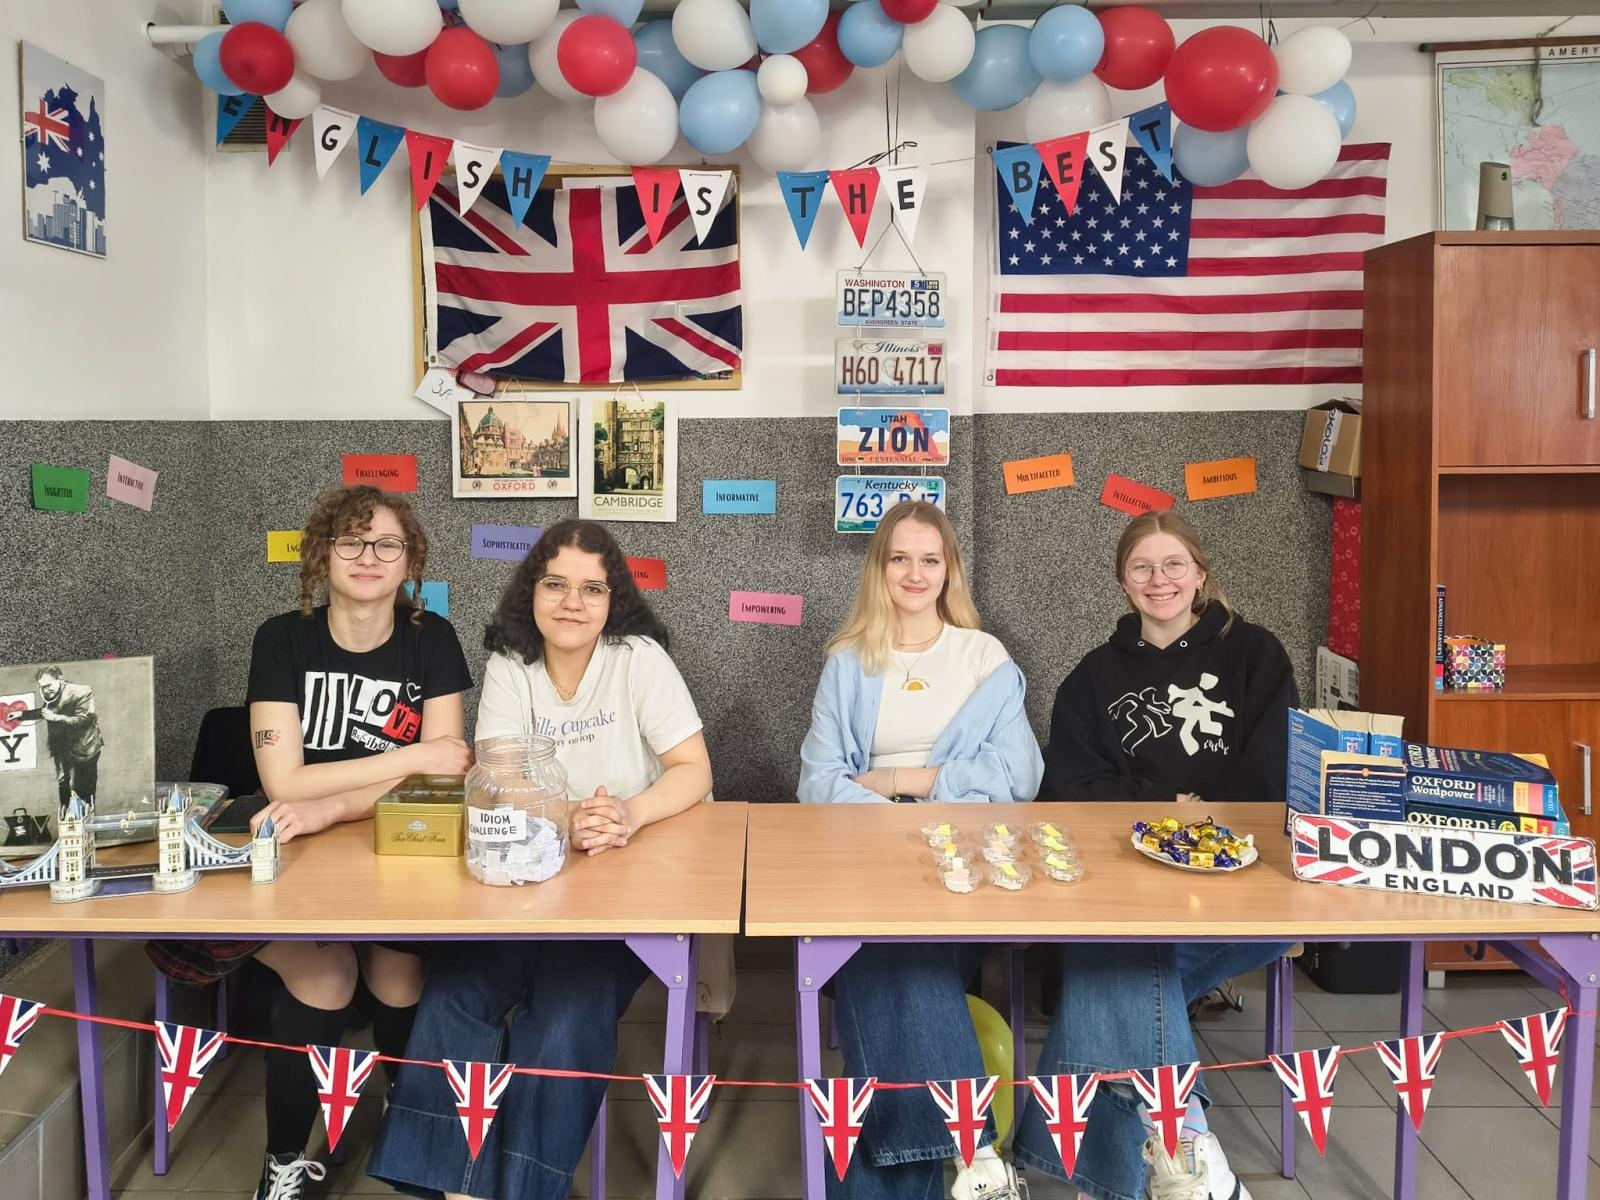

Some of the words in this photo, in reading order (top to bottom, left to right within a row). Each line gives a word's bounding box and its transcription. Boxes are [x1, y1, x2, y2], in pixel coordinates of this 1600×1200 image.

[223, 95, 532, 199] ENGLISH
[653, 183, 712, 216] IS
[792, 180, 915, 218] THE
[1012, 119, 1162, 194] BEST
[845, 278, 905, 288] WASHINGTON
[843, 288, 940, 318] BEP4358
[870, 341, 920, 353] Illinois
[893, 356, 942, 385] 4717
[880, 415, 907, 423] UTAH
[858, 427, 929, 453] ZION
[355, 469, 399, 478] CHALLENGING
[1016, 469, 1060, 483] MULTIFACETED
[1202, 473, 1238, 485] AMBITIOUS
[493, 483, 536, 491] OXFORD
[865, 480, 918, 491] Kentucky
[594, 497, 663, 508] CAMBRIDGE
[715, 492, 759, 502] INFORMATIVE
[841, 492, 883, 518] 763
[741, 603, 786, 615] EMPOWERING
[350, 678, 417, 741] LOVE
[535, 716, 556, 736] illa
[561, 708, 616, 736] Cupcake
[1411, 775, 1476, 791] OXFORD
[1412, 785, 1475, 800] Wordpower
[480, 813, 511, 824] IDIOM
[1407, 811, 1489, 830] OXFORD
[469, 823, 517, 835] CHALLENGE
[1318, 826, 1573, 887] LONDON
[1385, 874, 1514, 901] ENGLAND
